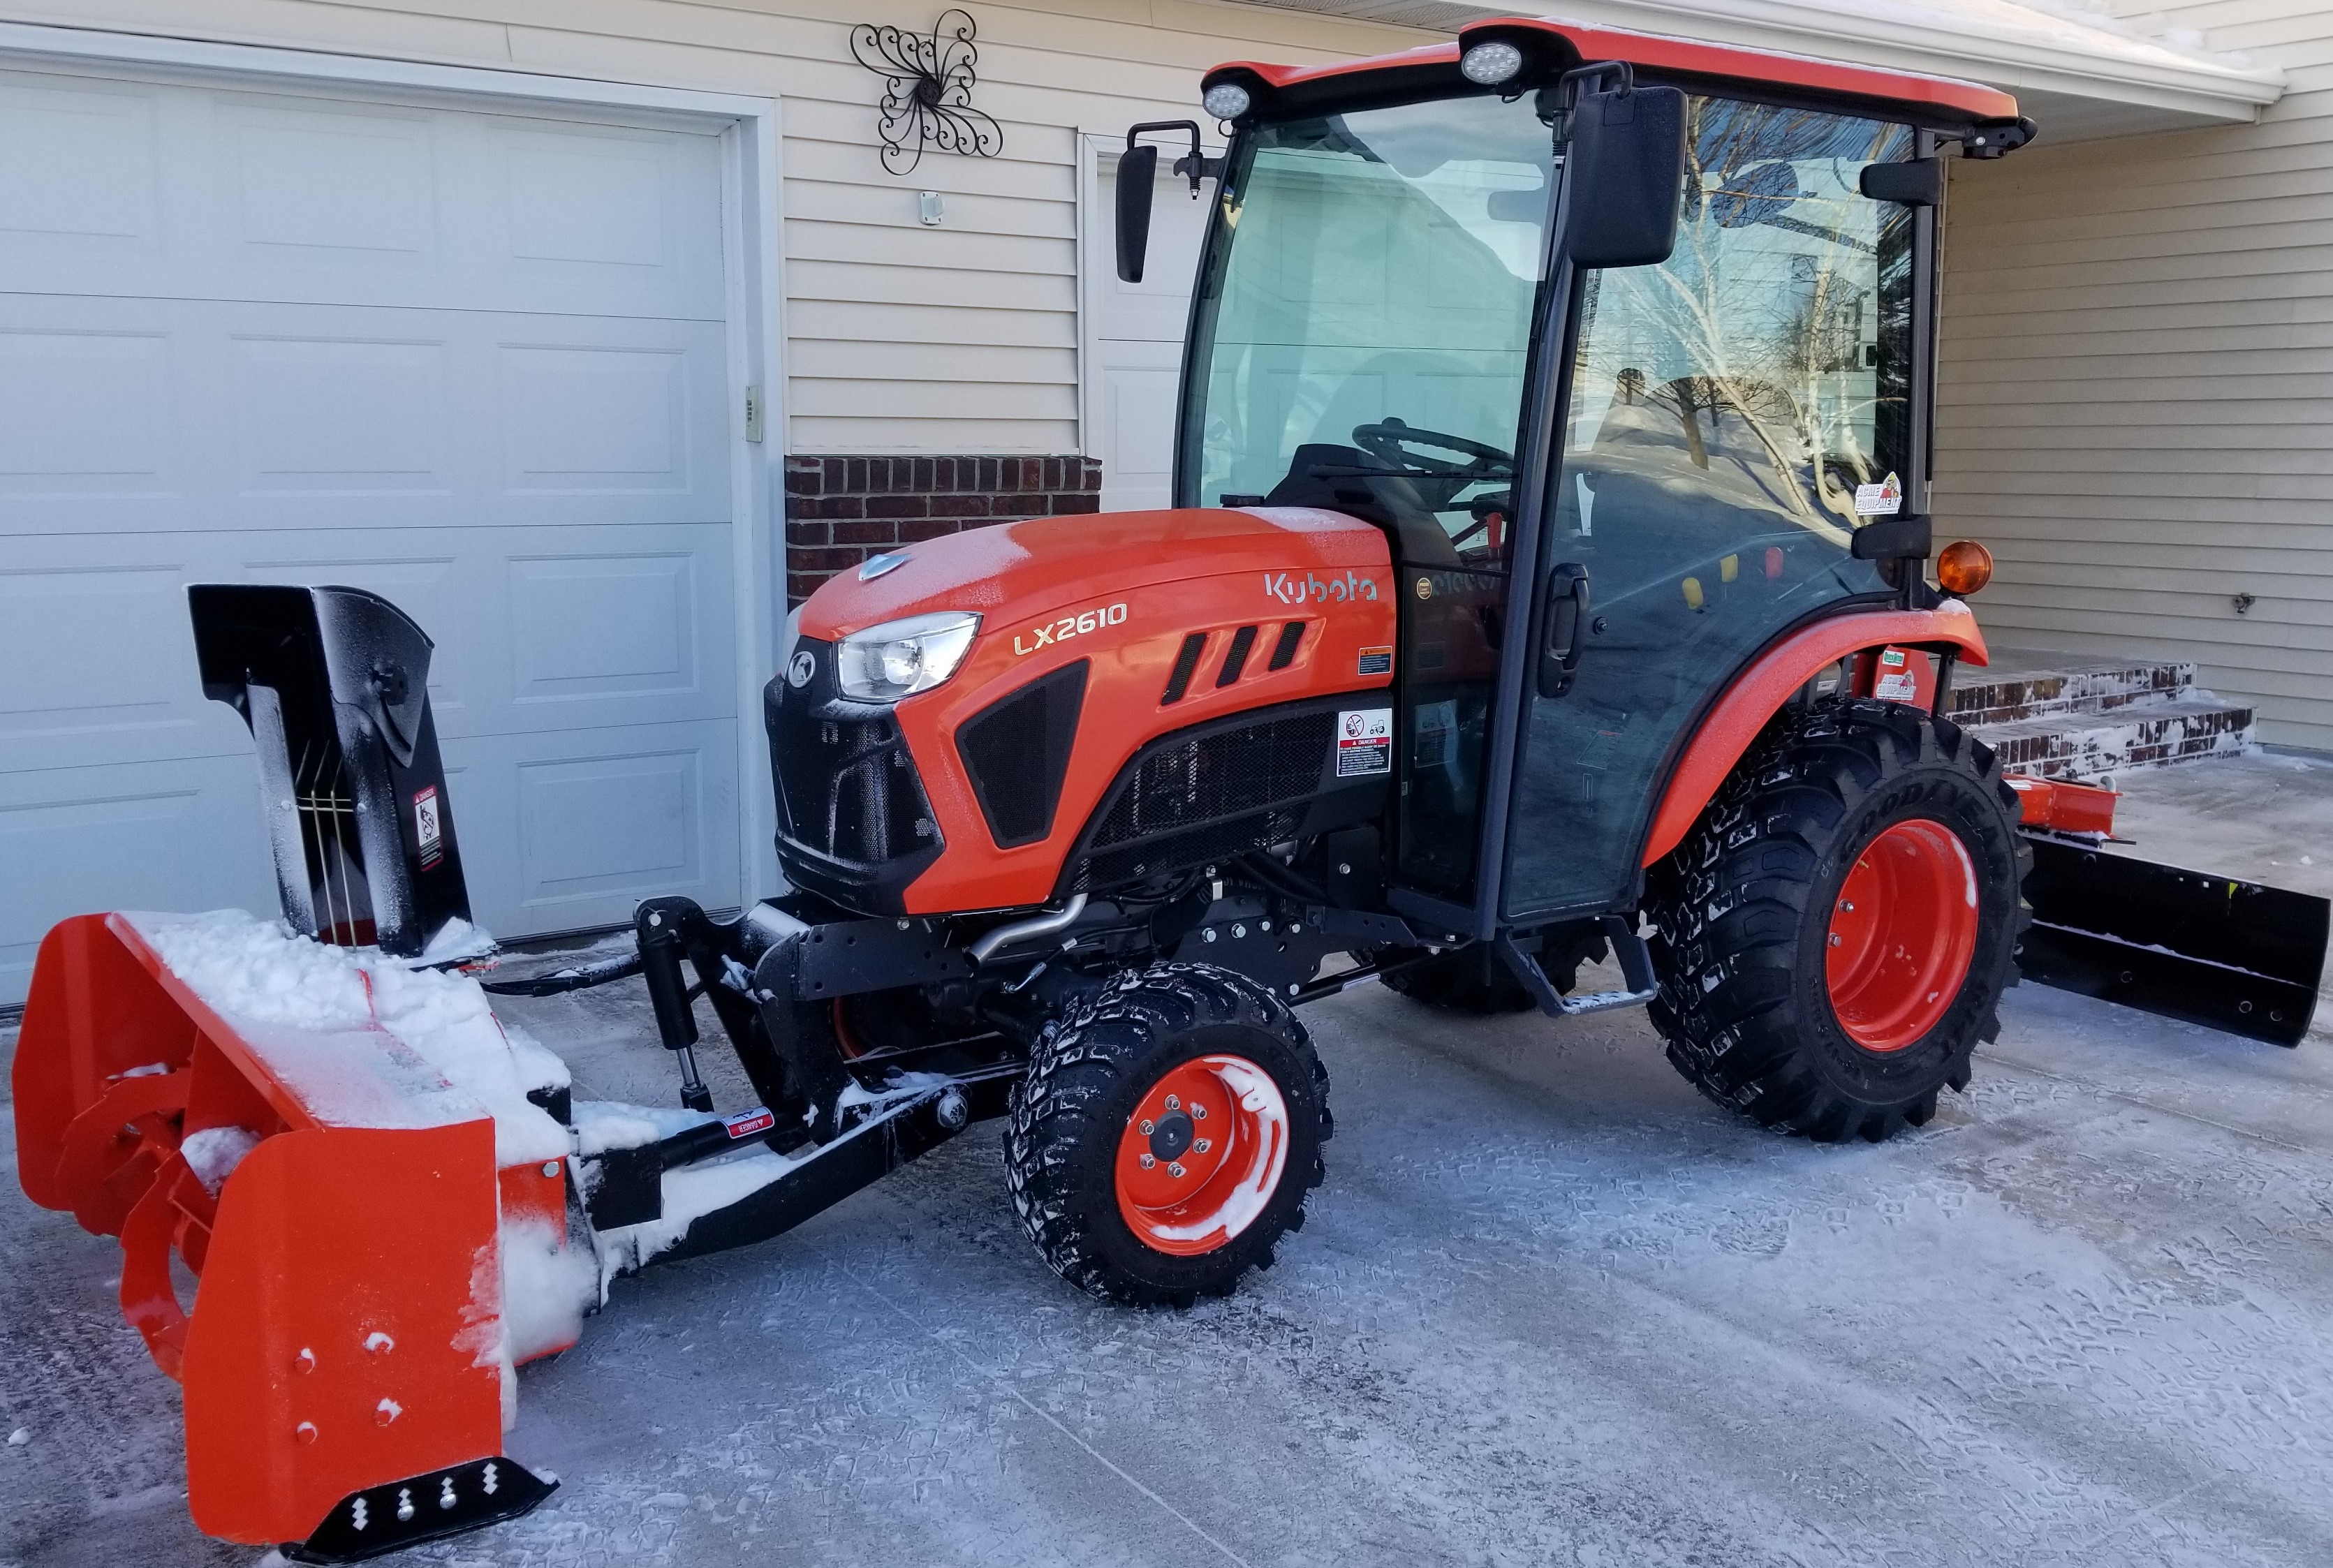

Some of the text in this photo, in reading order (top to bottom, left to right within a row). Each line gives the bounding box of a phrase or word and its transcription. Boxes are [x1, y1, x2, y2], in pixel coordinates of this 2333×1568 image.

[1856, 486, 1881, 497] ACME
[1855, 497, 1901, 510] EQUIPMENT
[1264, 570, 1377, 605] Kubota
[1013, 602, 1128, 656] LX2610
[1883, 675, 1902, 685] ACME
[738, 1120, 758, 1132] DANGER
